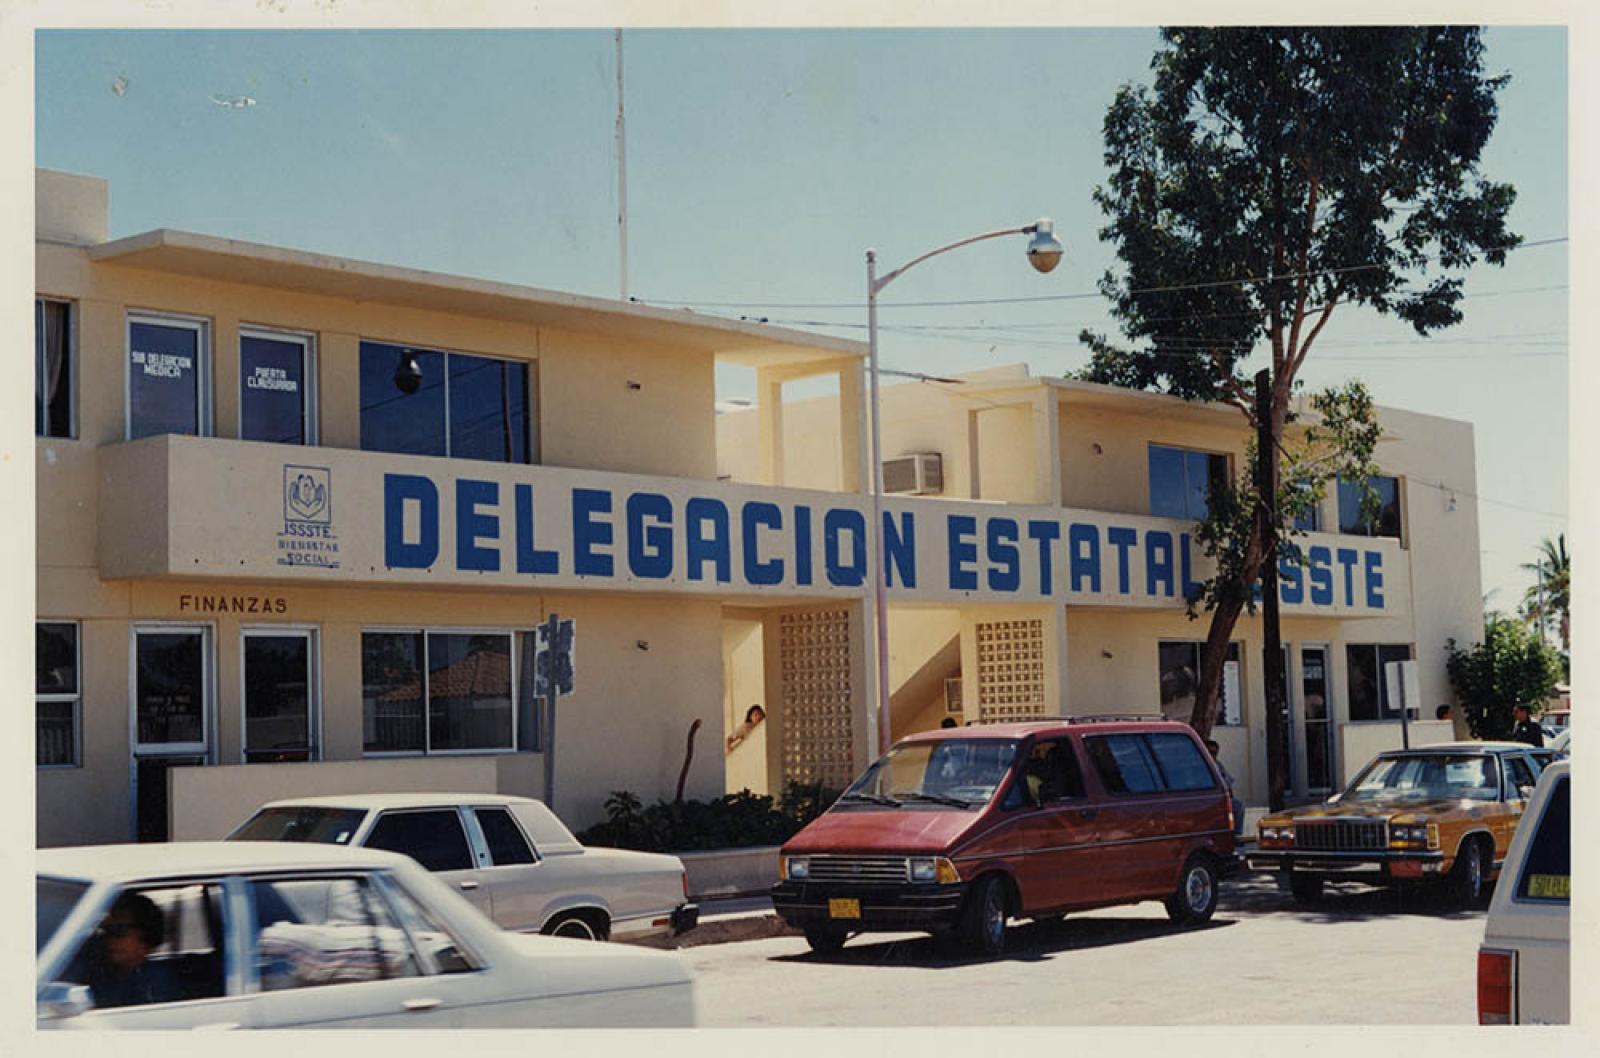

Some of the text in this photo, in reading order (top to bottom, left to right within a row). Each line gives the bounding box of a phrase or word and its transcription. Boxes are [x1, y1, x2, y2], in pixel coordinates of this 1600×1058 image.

[144, 364, 181, 378] MEDICA
[284, 521, 331, 538] ISSSTE
[278, 540, 339, 552] BIENESTAR
[384, 473, 1385, 609] DELEGACION ESTATAL SSTE
[287, 553, 331, 565] SOCIAL
[180, 595, 287, 613] FINANZAS
